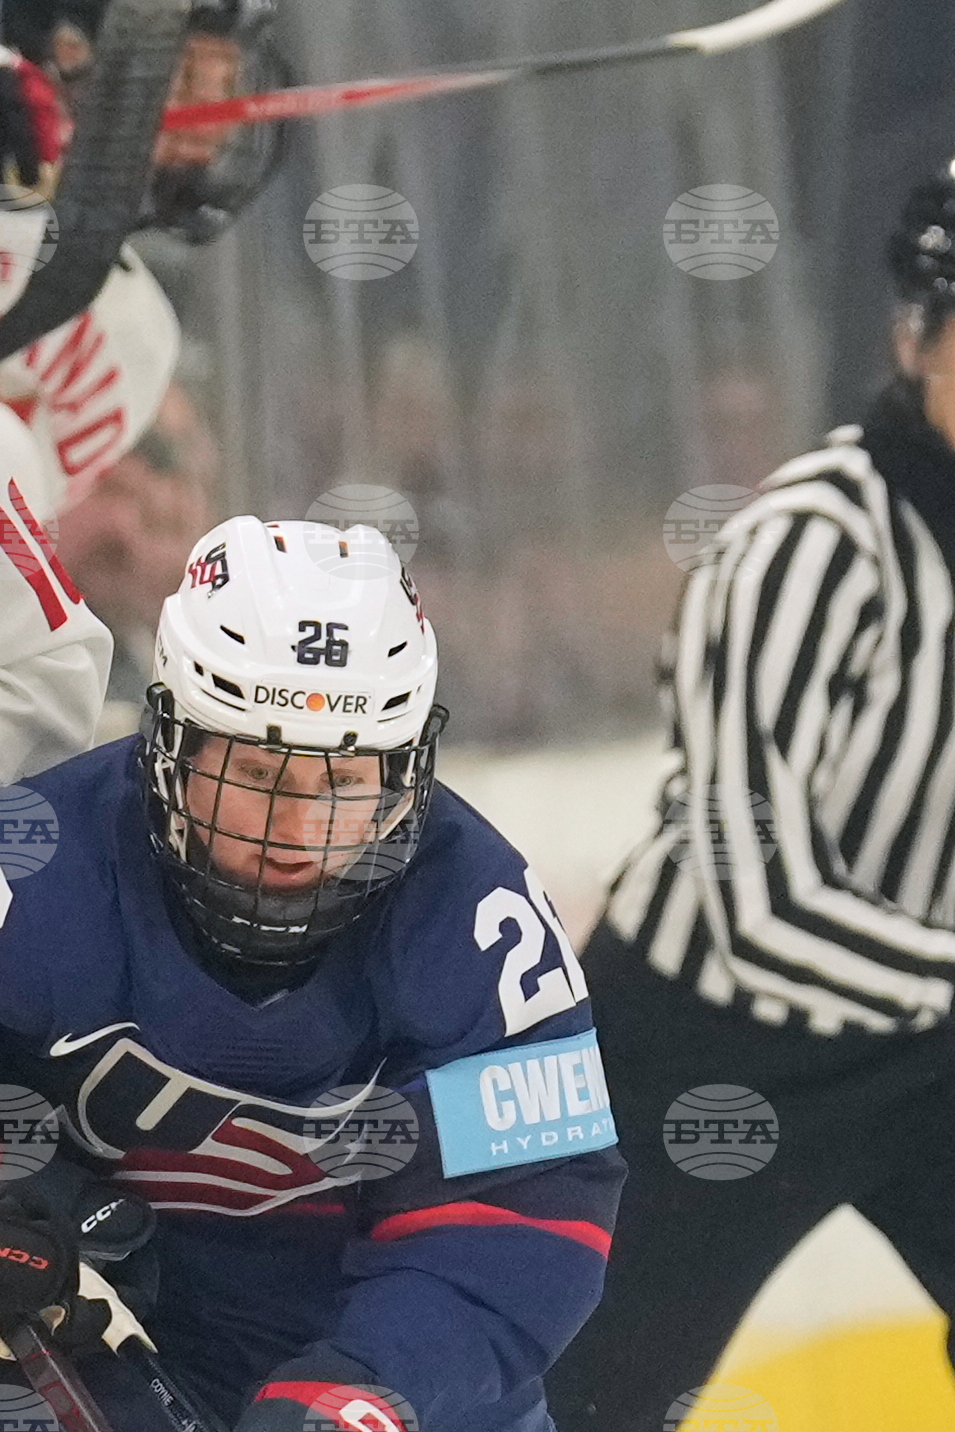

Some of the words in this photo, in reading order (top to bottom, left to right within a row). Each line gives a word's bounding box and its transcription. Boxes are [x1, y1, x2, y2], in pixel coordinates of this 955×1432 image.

[296, 619, 349, 668] 26
[254, 685, 368, 715] DISCOVER
[490, 1117, 614, 1157] HYDRAT
